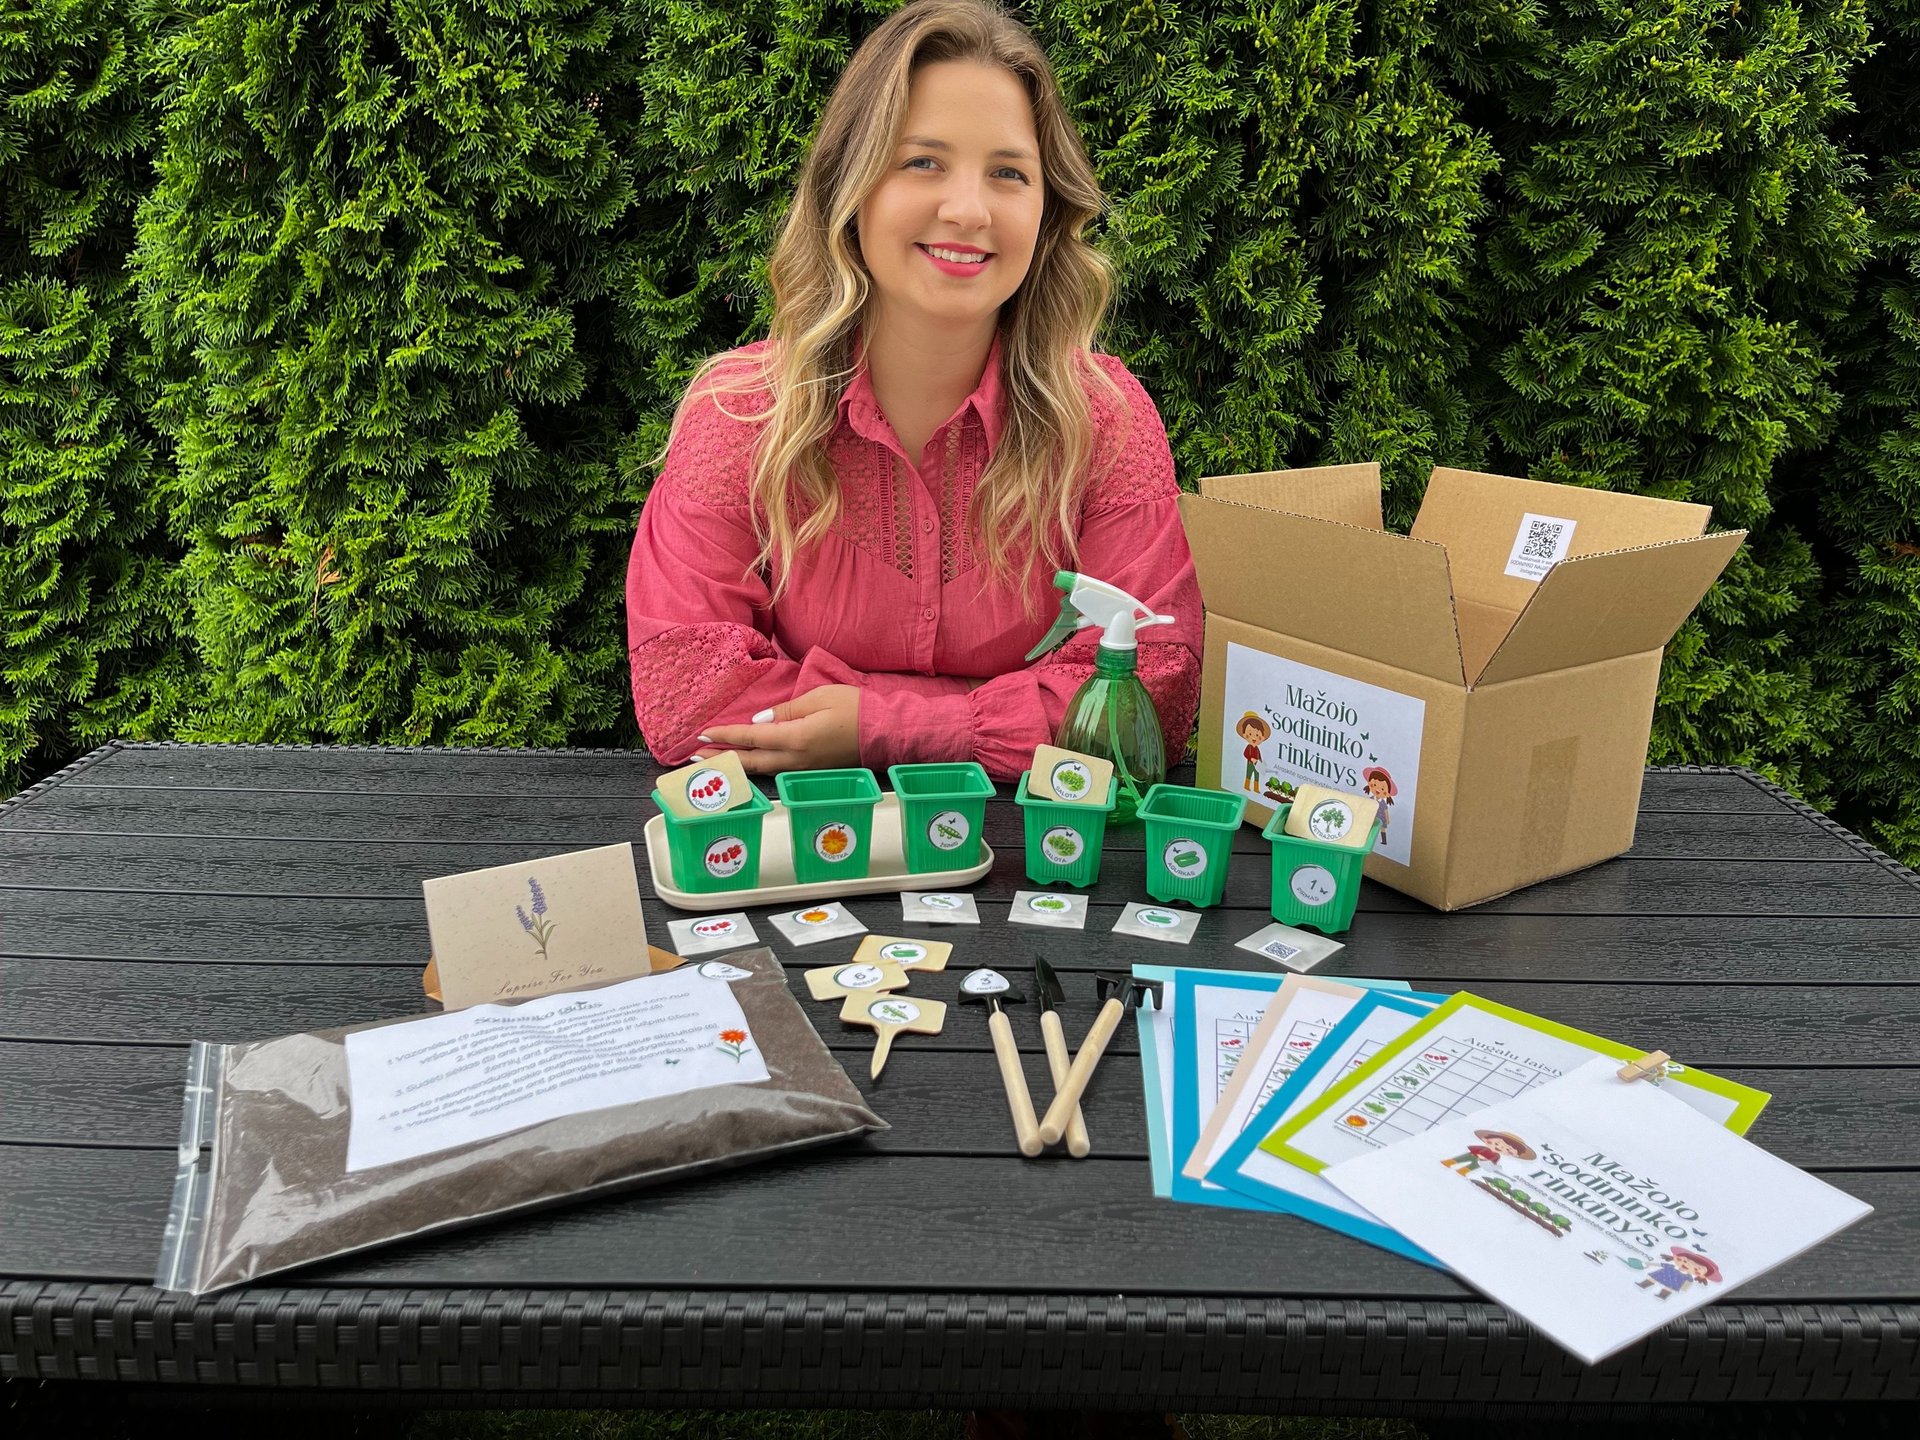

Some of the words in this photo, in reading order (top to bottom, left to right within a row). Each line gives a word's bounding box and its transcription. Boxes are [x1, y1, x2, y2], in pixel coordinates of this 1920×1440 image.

[1285, 684, 1358, 727] Mažojo
[1271, 712, 1363, 759] sodininko
[1278, 743, 1357, 787] rinkinys
[1055, 785, 1078, 799] SALOTA
[820, 850, 849, 860] MEDETKA
[1044, 849, 1067, 864] SALOTA
[1167, 861, 1197, 877] AGURKAS
[1309, 879, 1318, 890] 1
[549, 968, 572, 985] For
[577, 963, 603, 979] You
[980, 977, 992, 985] 3
[1542, 1151, 1689, 1240] sodininko
[1582, 1152, 1699, 1222] Mažojo
[1529, 1169, 1659, 1247] rinkinys
